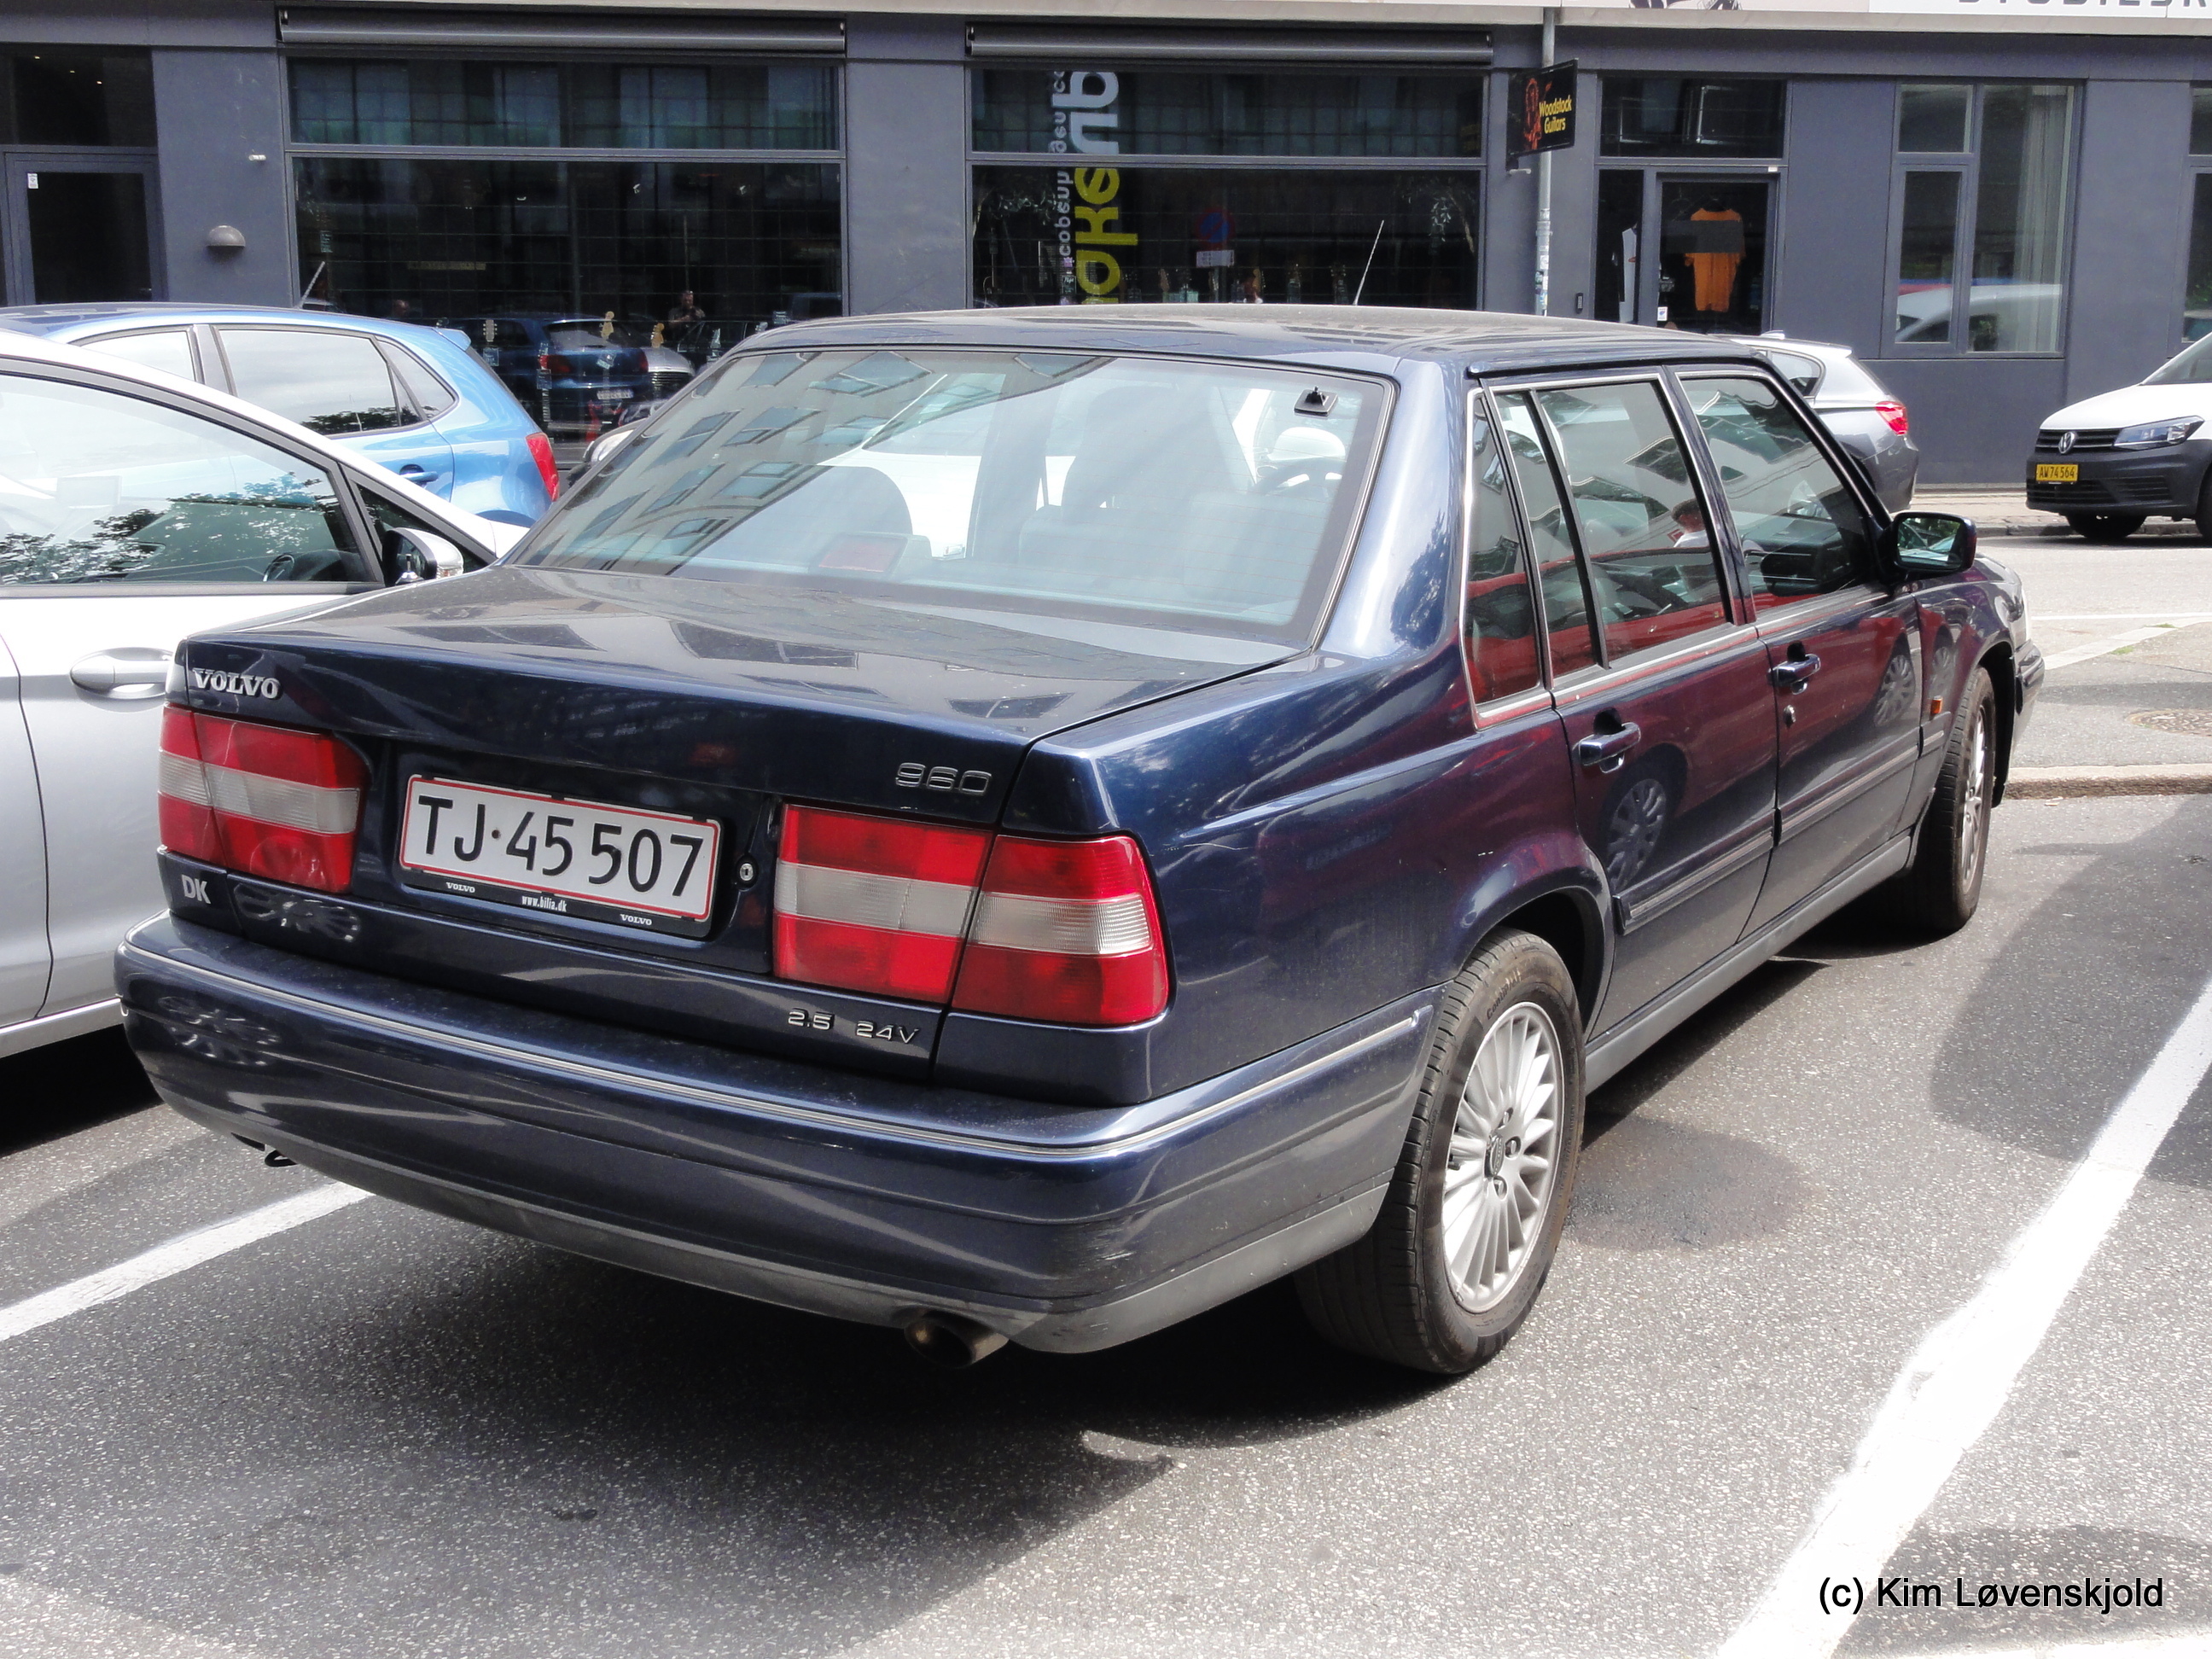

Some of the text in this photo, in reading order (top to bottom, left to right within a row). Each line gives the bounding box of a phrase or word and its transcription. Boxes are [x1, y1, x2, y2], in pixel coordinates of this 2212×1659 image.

[1539, 94, 1572, 118] Woodstock
[1544, 116, 1566, 134] Guitars
[192, 667, 282, 699] VOLVO
[895, 762, 992, 795] 960
[418, 795, 486, 862] TJ
[588, 823, 704, 897] 507
[181, 874, 212, 905] DK
[445, 882, 475, 894] VOLVO
[521, 895, 568, 912] www.bilia.dk
[620, 913, 653, 926] VOLVO
[788, 1008, 920, 1044] 2.5 24V
